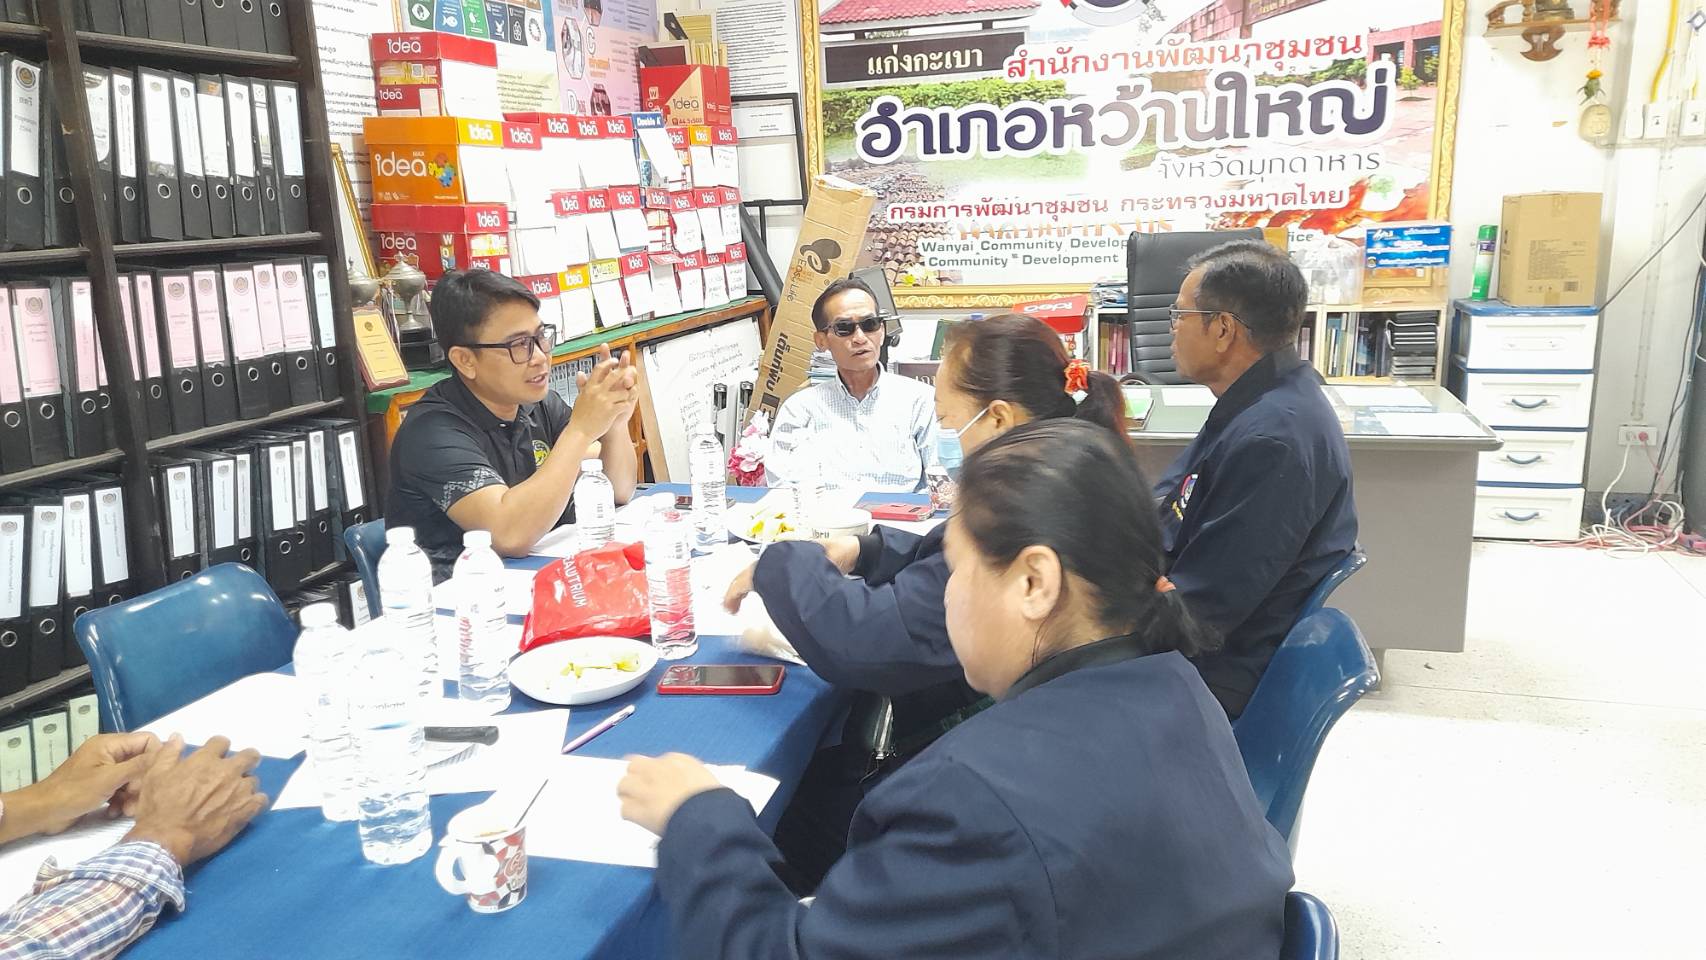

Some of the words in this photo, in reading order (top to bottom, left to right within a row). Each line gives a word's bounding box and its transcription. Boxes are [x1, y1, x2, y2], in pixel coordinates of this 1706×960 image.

[388, 37, 421, 53] idea
[868, 44, 983, 75] แก่งกะเบา
[1008, 34, 1361, 77] สำนักงานพัฒนาชุมชน
[380, 88, 403, 101] idea
[673, 96, 699, 110] idea
[861, 68, 1388, 157] อำเภอหว้านใหญ่
[510, 127, 534, 144] idea
[375, 151, 427, 176] idea
[1158, 151, 1380, 182] จังหวัดมุกดาหาร
[890, 196, 1109, 221] กรมการพัฒนาชุมชน
[1121, 182, 1343, 212] กระทรวงมหาดไทย
[477, 211, 500, 227] idea
[380, 232, 417, 251] idea
[922, 241, 975, 254] Wanyai
[981, 239, 1062, 252] Community
[1070, 237, 1129, 250] Develop
[929, 255, 1008, 268] Community
[1022, 253, 1119, 267] Development
[563, 554, 588, 608] EAUTRIUM
